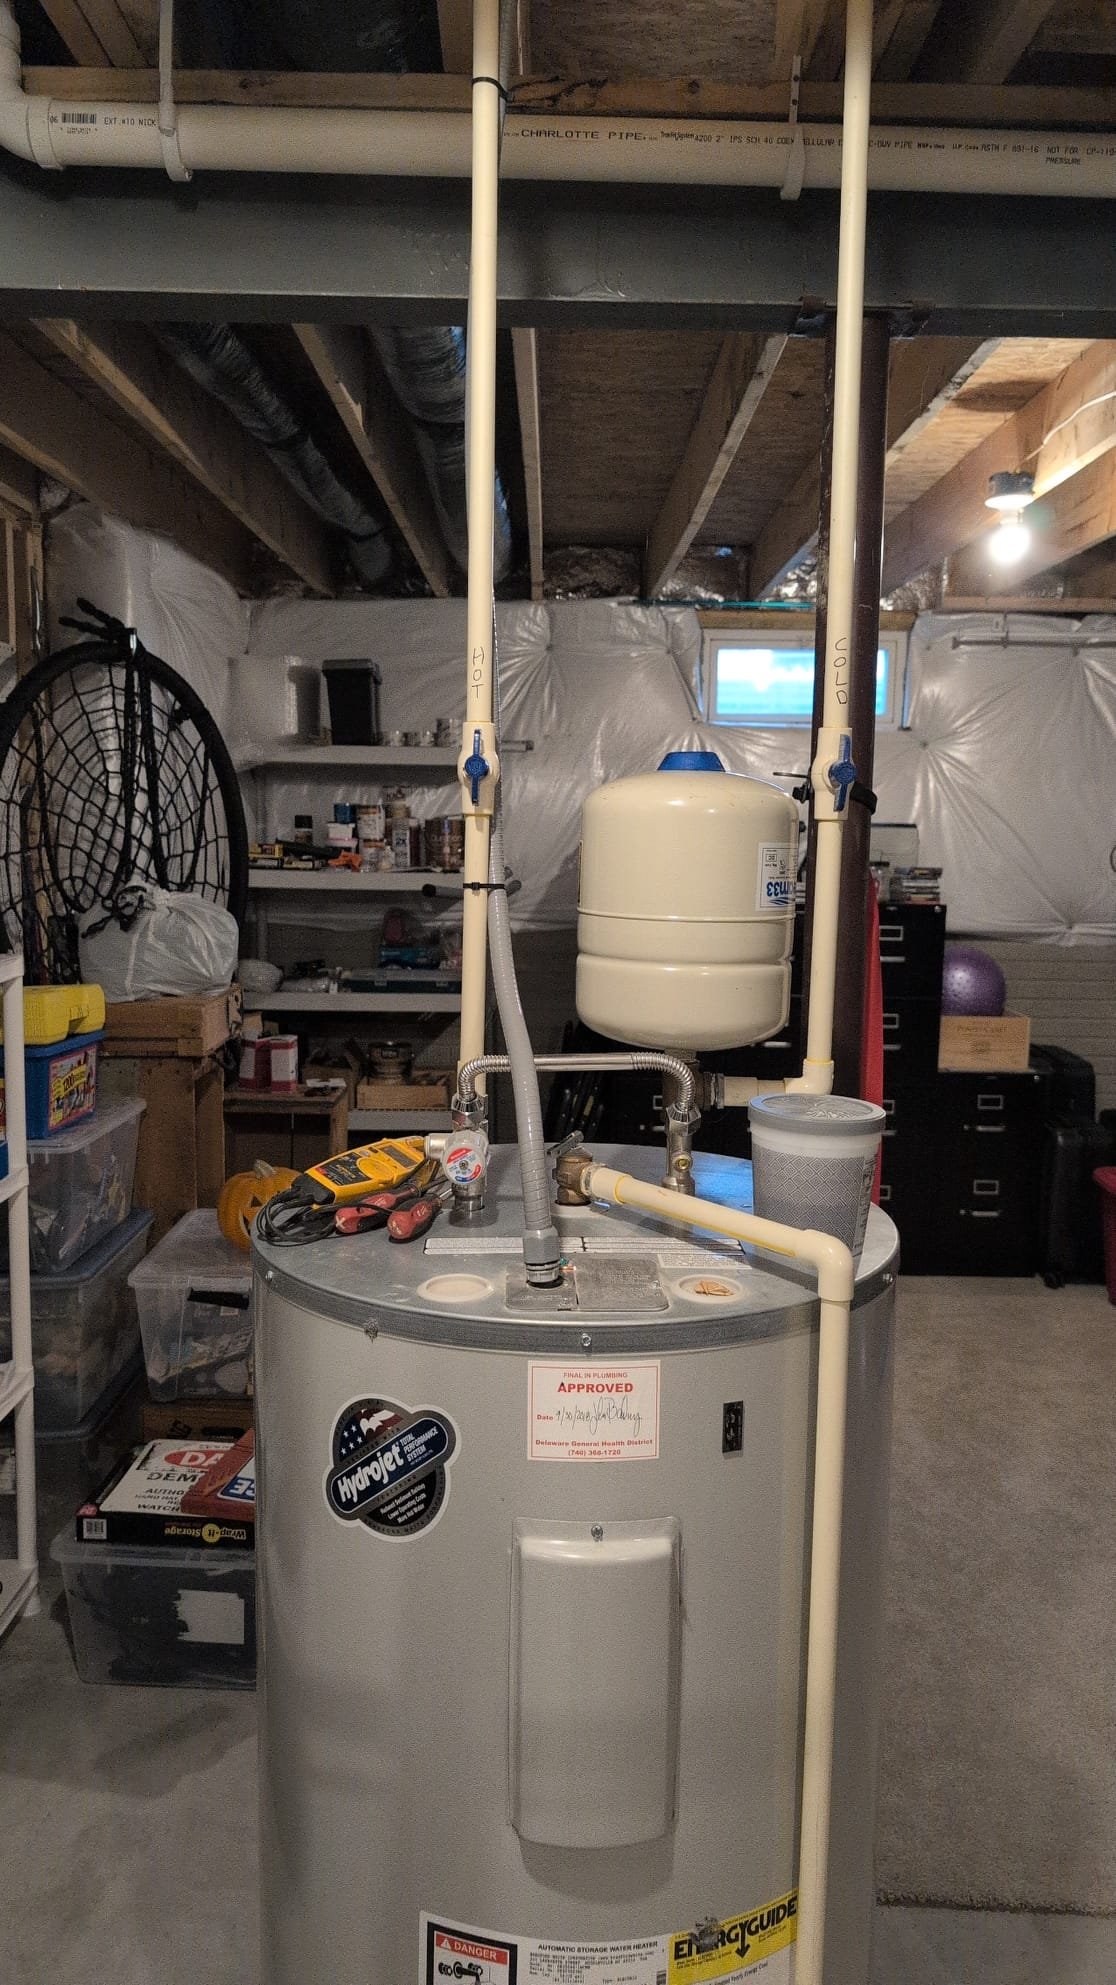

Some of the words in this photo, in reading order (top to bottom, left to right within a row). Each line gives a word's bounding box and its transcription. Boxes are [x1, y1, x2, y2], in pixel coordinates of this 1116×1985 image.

[521, 129, 599, 139] CHARLOTTE
[471, 646, 485, 699] HOT
[833, 637, 848, 705] COLD
[593, 1371, 628, 1379] PLUMBING
[557, 1382, 634, 1393] APPROVED
[400, 1432, 415, 1447] TOTAL
[403, 1426, 439, 1455] PERFORMANCE
[535, 1439, 570, 1447] Delaware
[626, 1439, 653, 1447] District
[406, 1445, 427, 1462] SYSTEM
[337, 1444, 404, 1503] Hydrojet
[164, 1526, 201, 1536] Storage
[454, 1940, 497, 1961] DANGER
[538, 1944, 576, 1953] AUTOMATIC
[609, 1944, 632, 1952] WATER
[633, 1941, 658, 1950] HEATER
